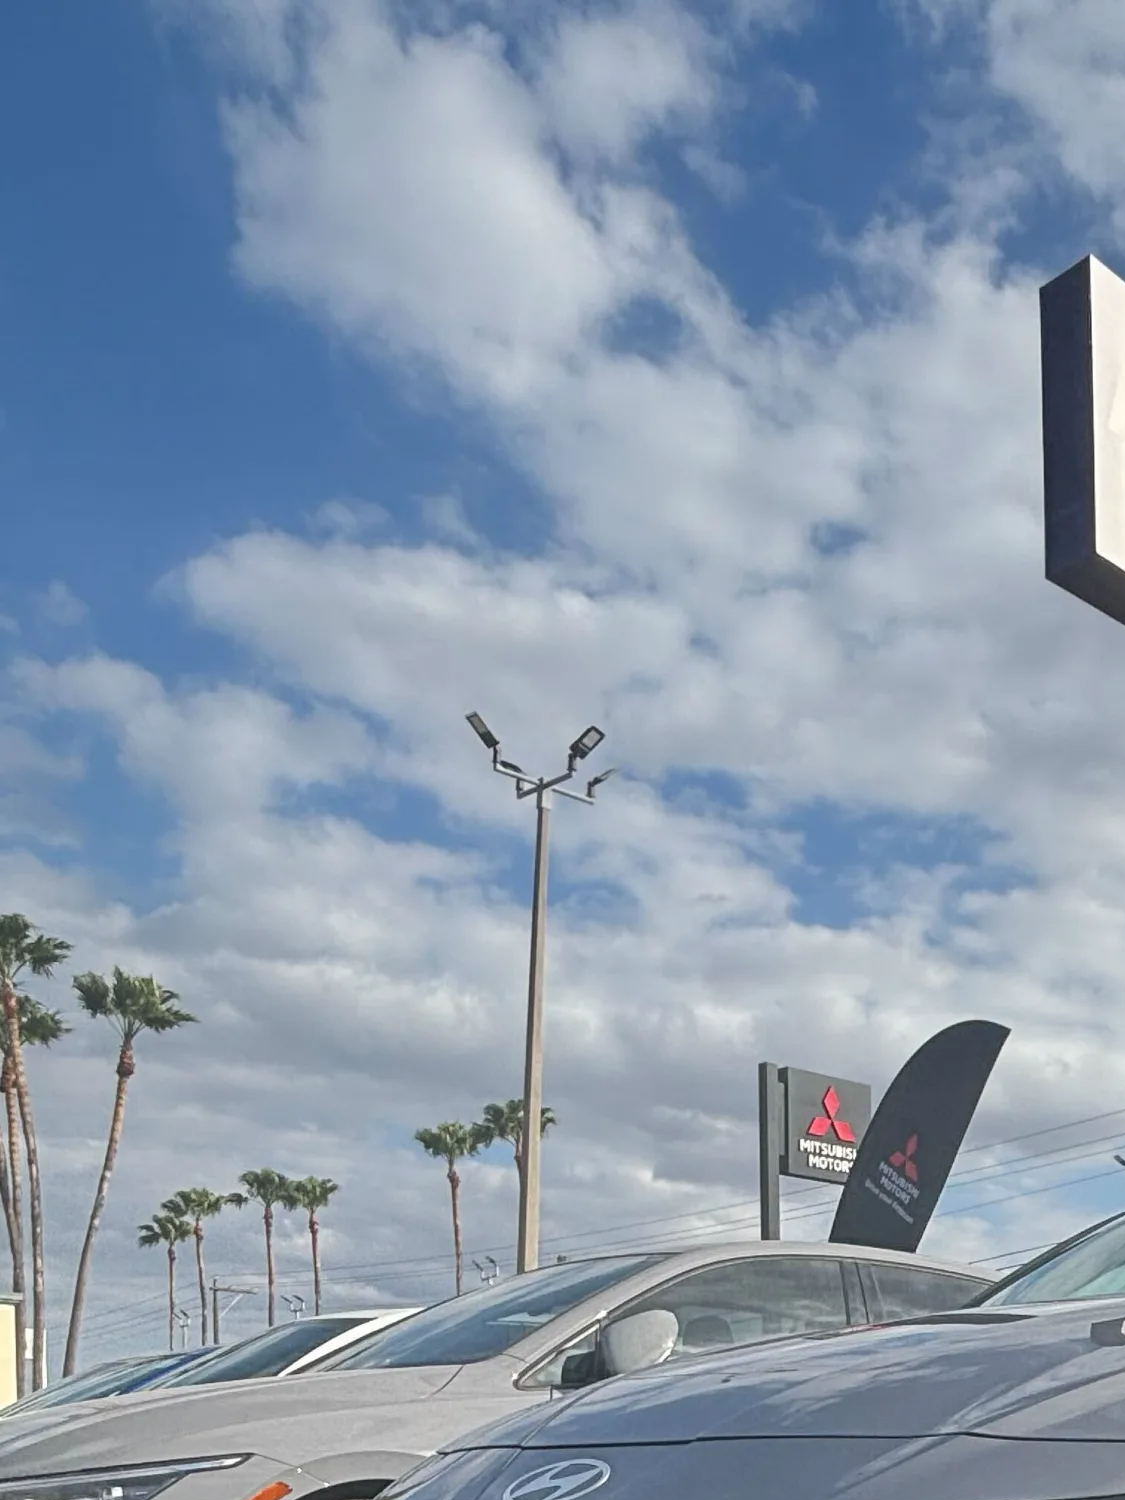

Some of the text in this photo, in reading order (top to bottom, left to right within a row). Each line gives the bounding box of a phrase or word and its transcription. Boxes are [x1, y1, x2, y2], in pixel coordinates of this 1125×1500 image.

[799, 1138, 857, 1161] MITSUBIS
[879, 1160, 920, 1199] MITSUBISHI
[880, 1176, 911, 1205] MOTORS
